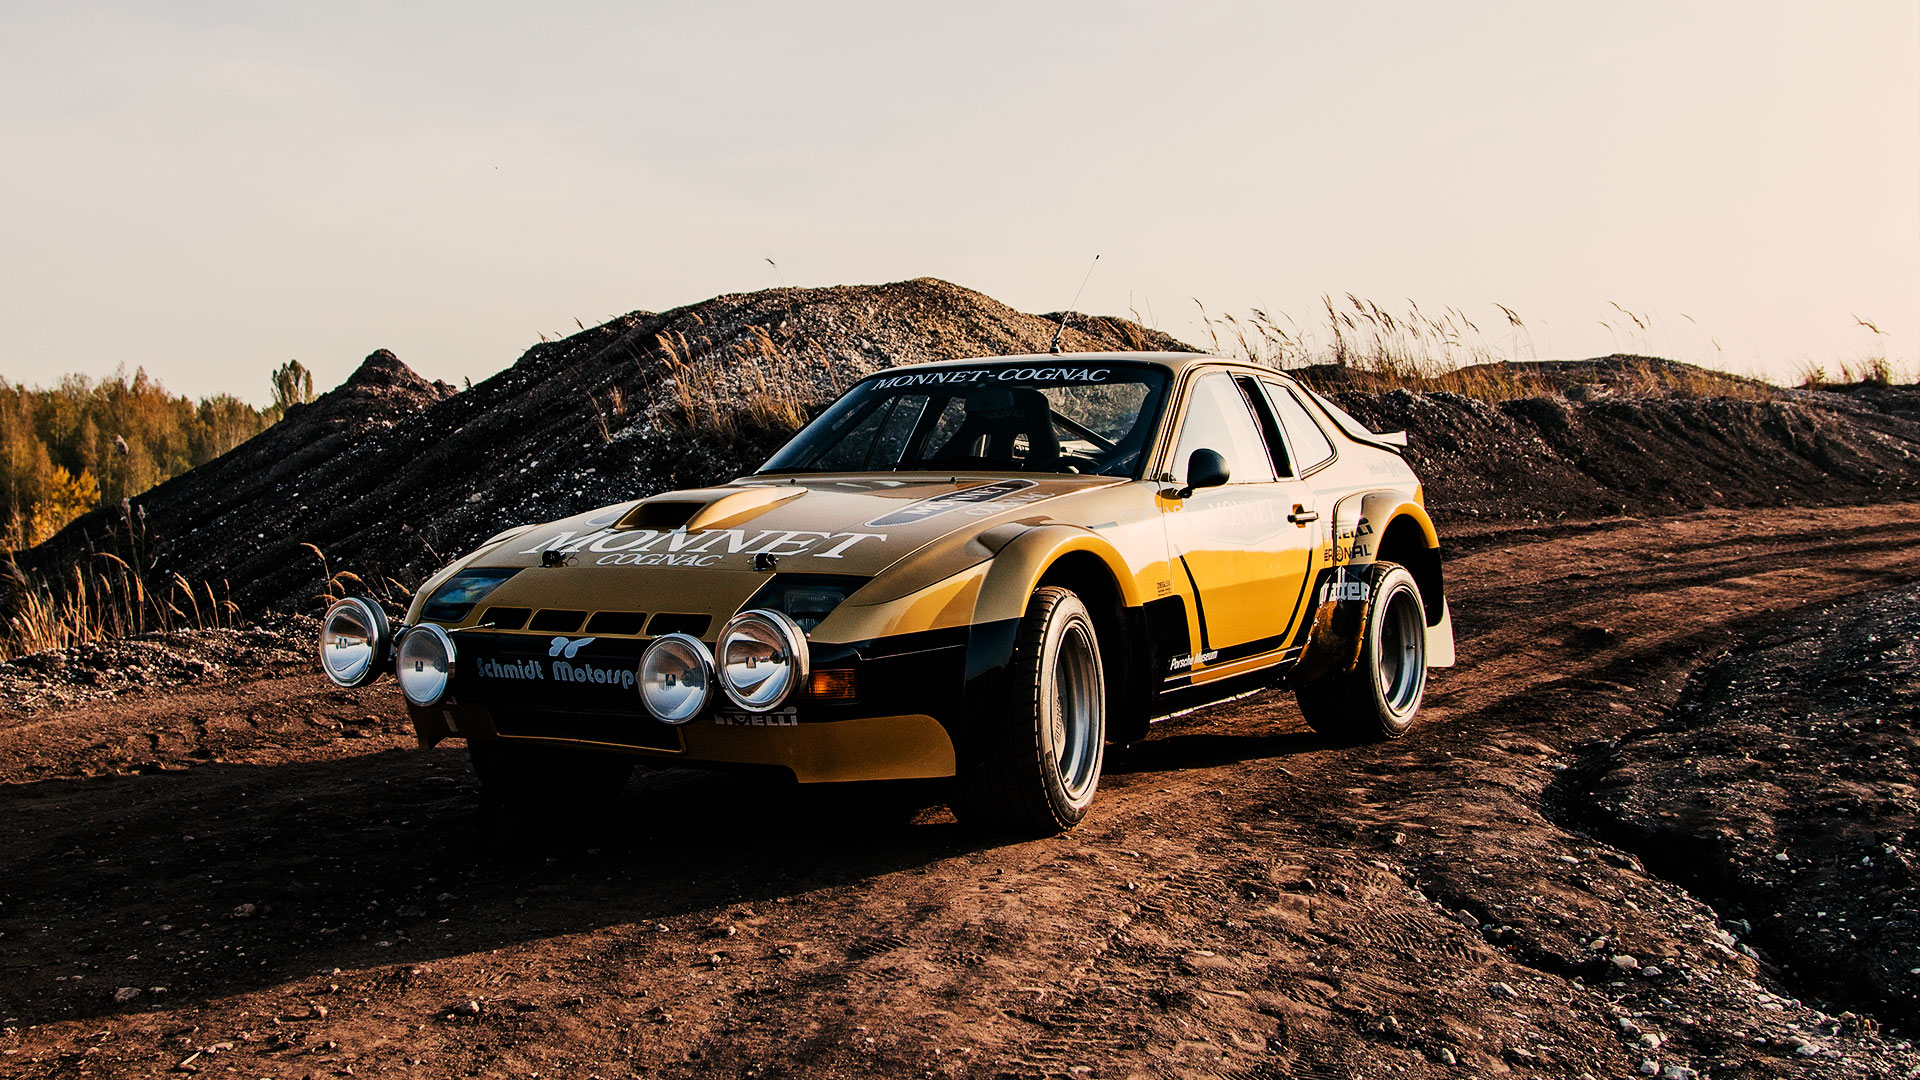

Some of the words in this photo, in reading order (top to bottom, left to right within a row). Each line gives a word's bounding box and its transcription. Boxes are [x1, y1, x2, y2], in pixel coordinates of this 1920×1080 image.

[870, 368, 1110, 391] MONNET-COGNAC
[518, 525, 888, 559] MONNET
[595, 553, 723, 568] COGNAC
[1169, 654, 1194, 671] Porsche
[1194, 650, 1218, 664] Museum
[476, 657, 544, 680] Schmidt
[552, 660, 639, 690] Motorsp
